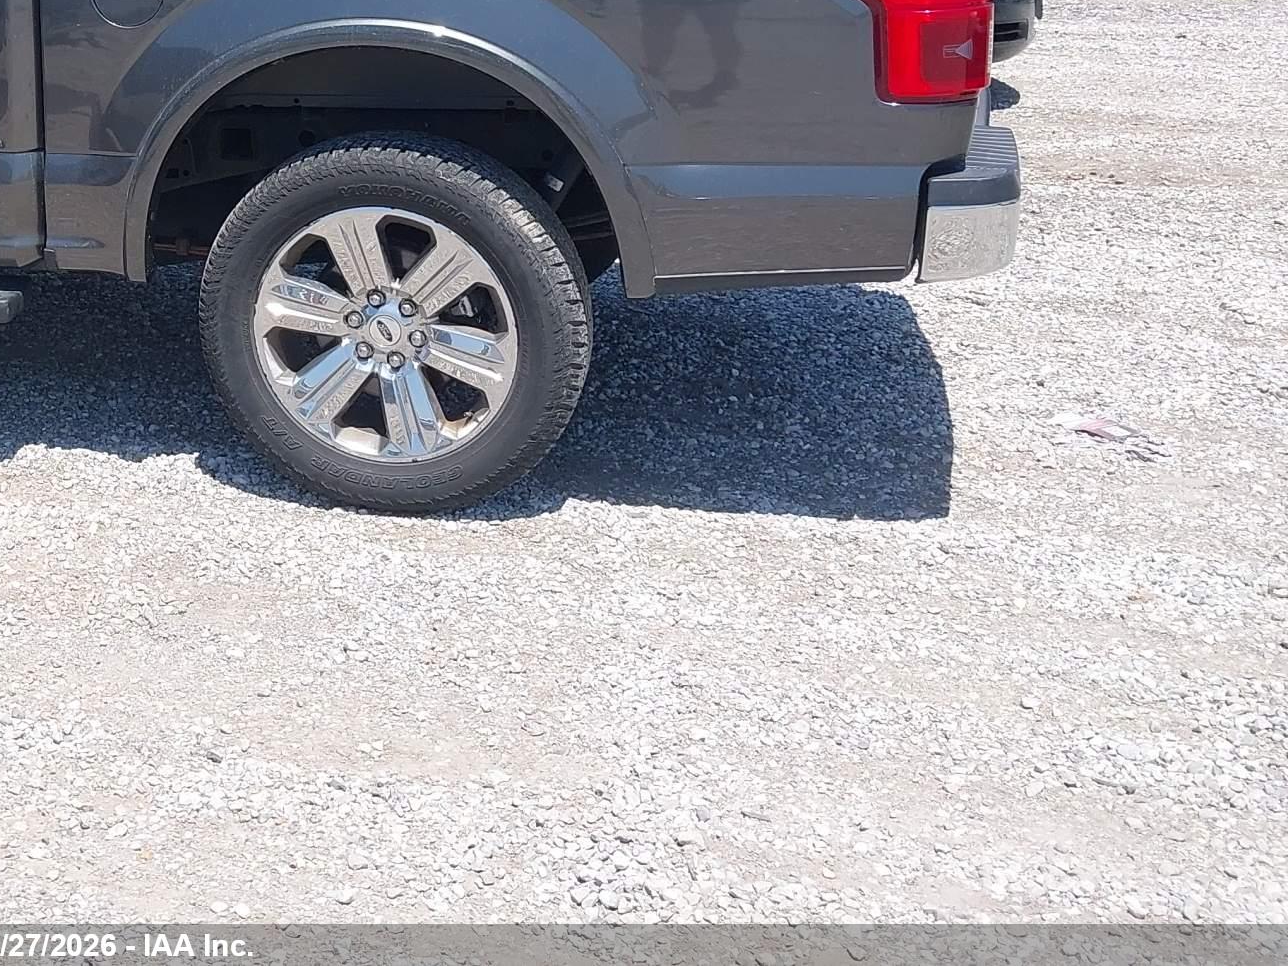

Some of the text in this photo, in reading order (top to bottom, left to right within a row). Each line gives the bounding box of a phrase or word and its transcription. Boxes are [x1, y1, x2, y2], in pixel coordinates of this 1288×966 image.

[338, 183, 472, 227] YOKOHAMA
[262, 415, 463, 490] GEOLANDAR A/T
